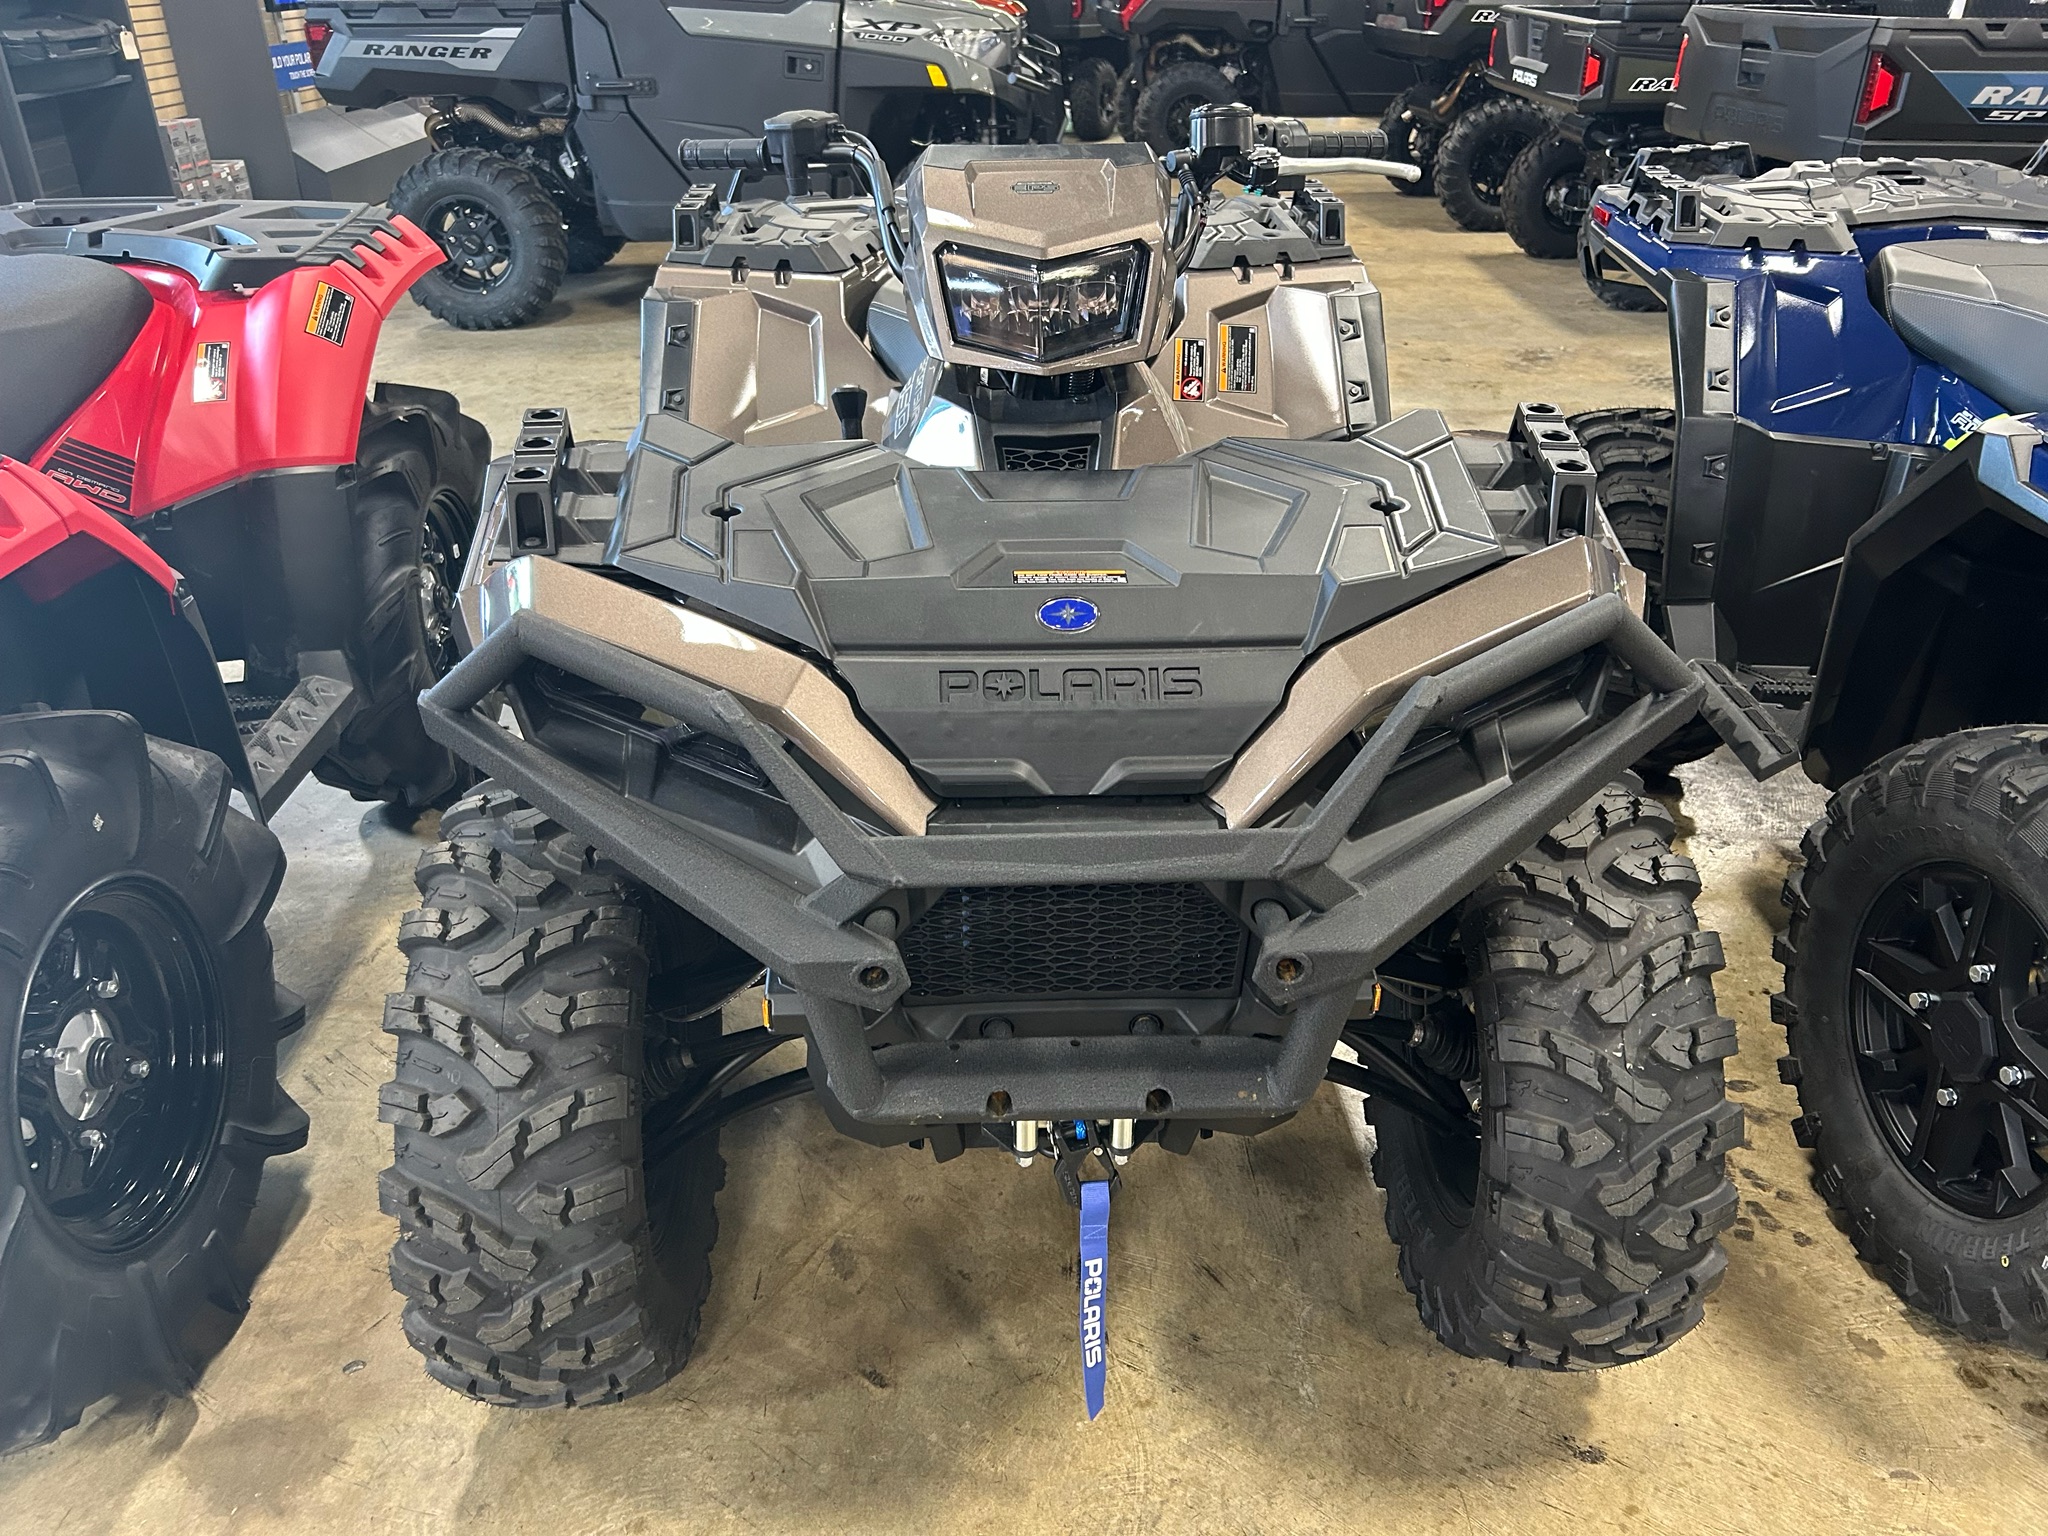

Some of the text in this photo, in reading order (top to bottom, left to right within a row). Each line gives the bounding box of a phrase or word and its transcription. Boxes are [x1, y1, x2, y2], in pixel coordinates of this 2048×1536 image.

[1471, 10, 1500, 23] R
[853, 18, 922, 32] XP
[859, 32, 909, 43] 1000
[363, 44, 493, 59] RANGER
[1512, 68, 1538, 88] POLARIS
[1984, 110, 2048, 121] SP
[76, 474, 121, 494] DEMAND
[938, 667, 1203, 703] POLARIS
[1083, 1257, 1103, 1368] POLARIS
